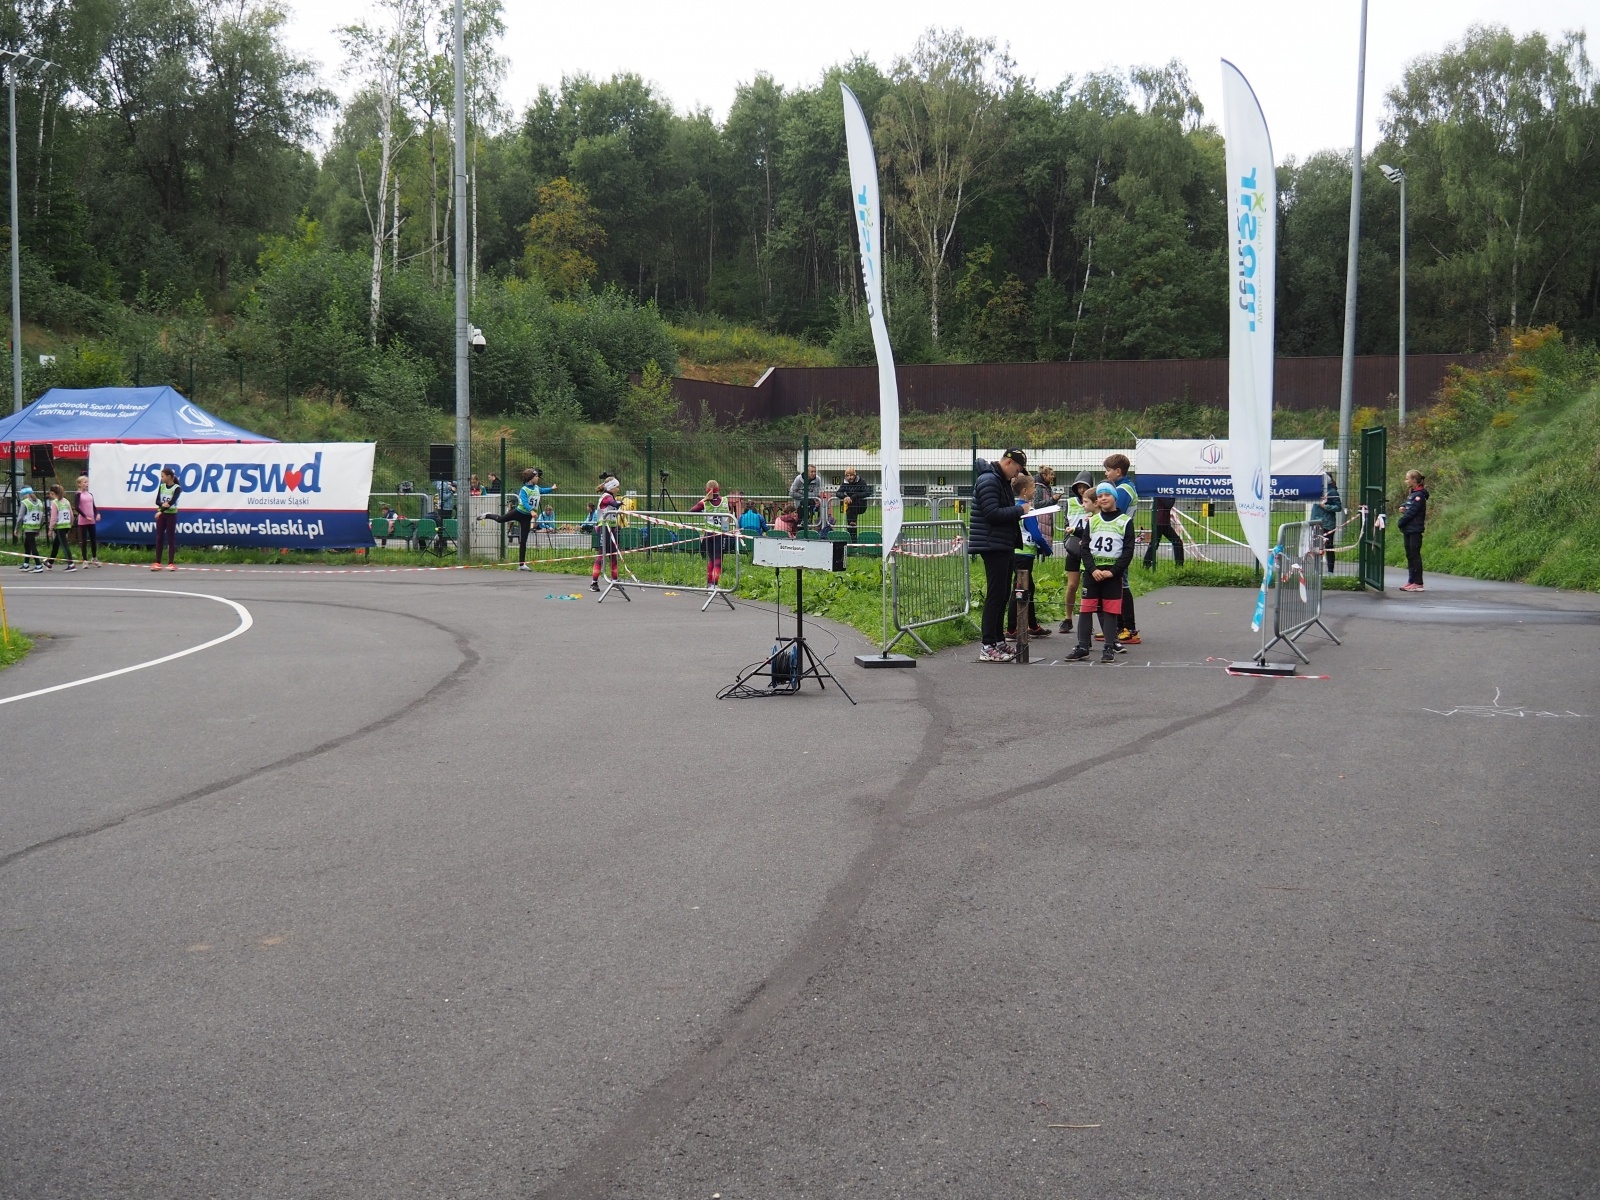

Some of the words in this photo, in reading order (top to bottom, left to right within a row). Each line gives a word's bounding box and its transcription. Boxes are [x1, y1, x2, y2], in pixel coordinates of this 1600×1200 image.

[89, 403, 113, 411] Sportu
[832, 476, 840, 485] 10
[1177, 477, 1211, 486] MIASTO
[1212, 478, 1232, 486] WSP
[1176, 487, 1208, 495] STRZAŁ
[247, 497, 286, 505] Wodzisław
[288, 495, 310, 507] Śląski
[529, 497, 538, 506] 51
[32, 513, 40, 521] 54
[1094, 536, 1113, 552] 43
